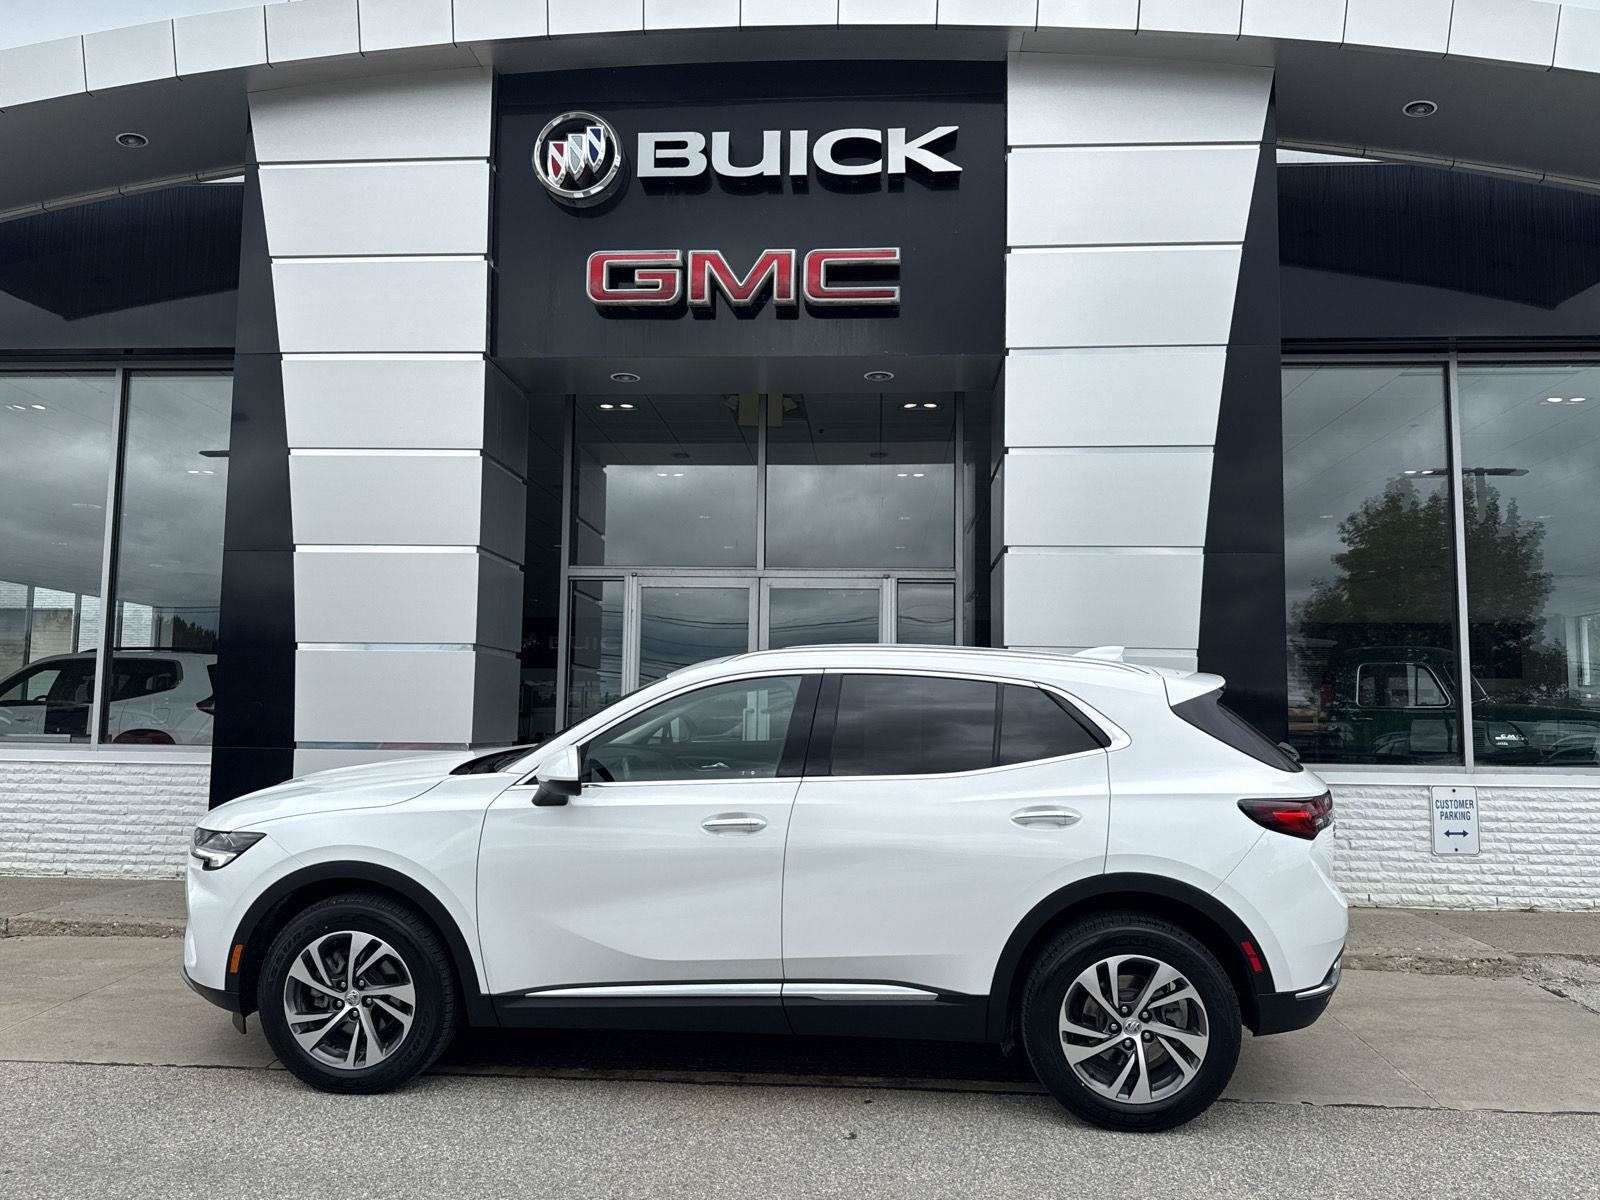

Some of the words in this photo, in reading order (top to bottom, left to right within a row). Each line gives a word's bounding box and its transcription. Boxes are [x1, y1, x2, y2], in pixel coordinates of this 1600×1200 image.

[637, 125, 963, 178] BUICK
[586, 247, 900, 305] GMC
[1435, 799, 1474, 809] CUSTOMER
[1440, 811, 1471, 820] PARKING
